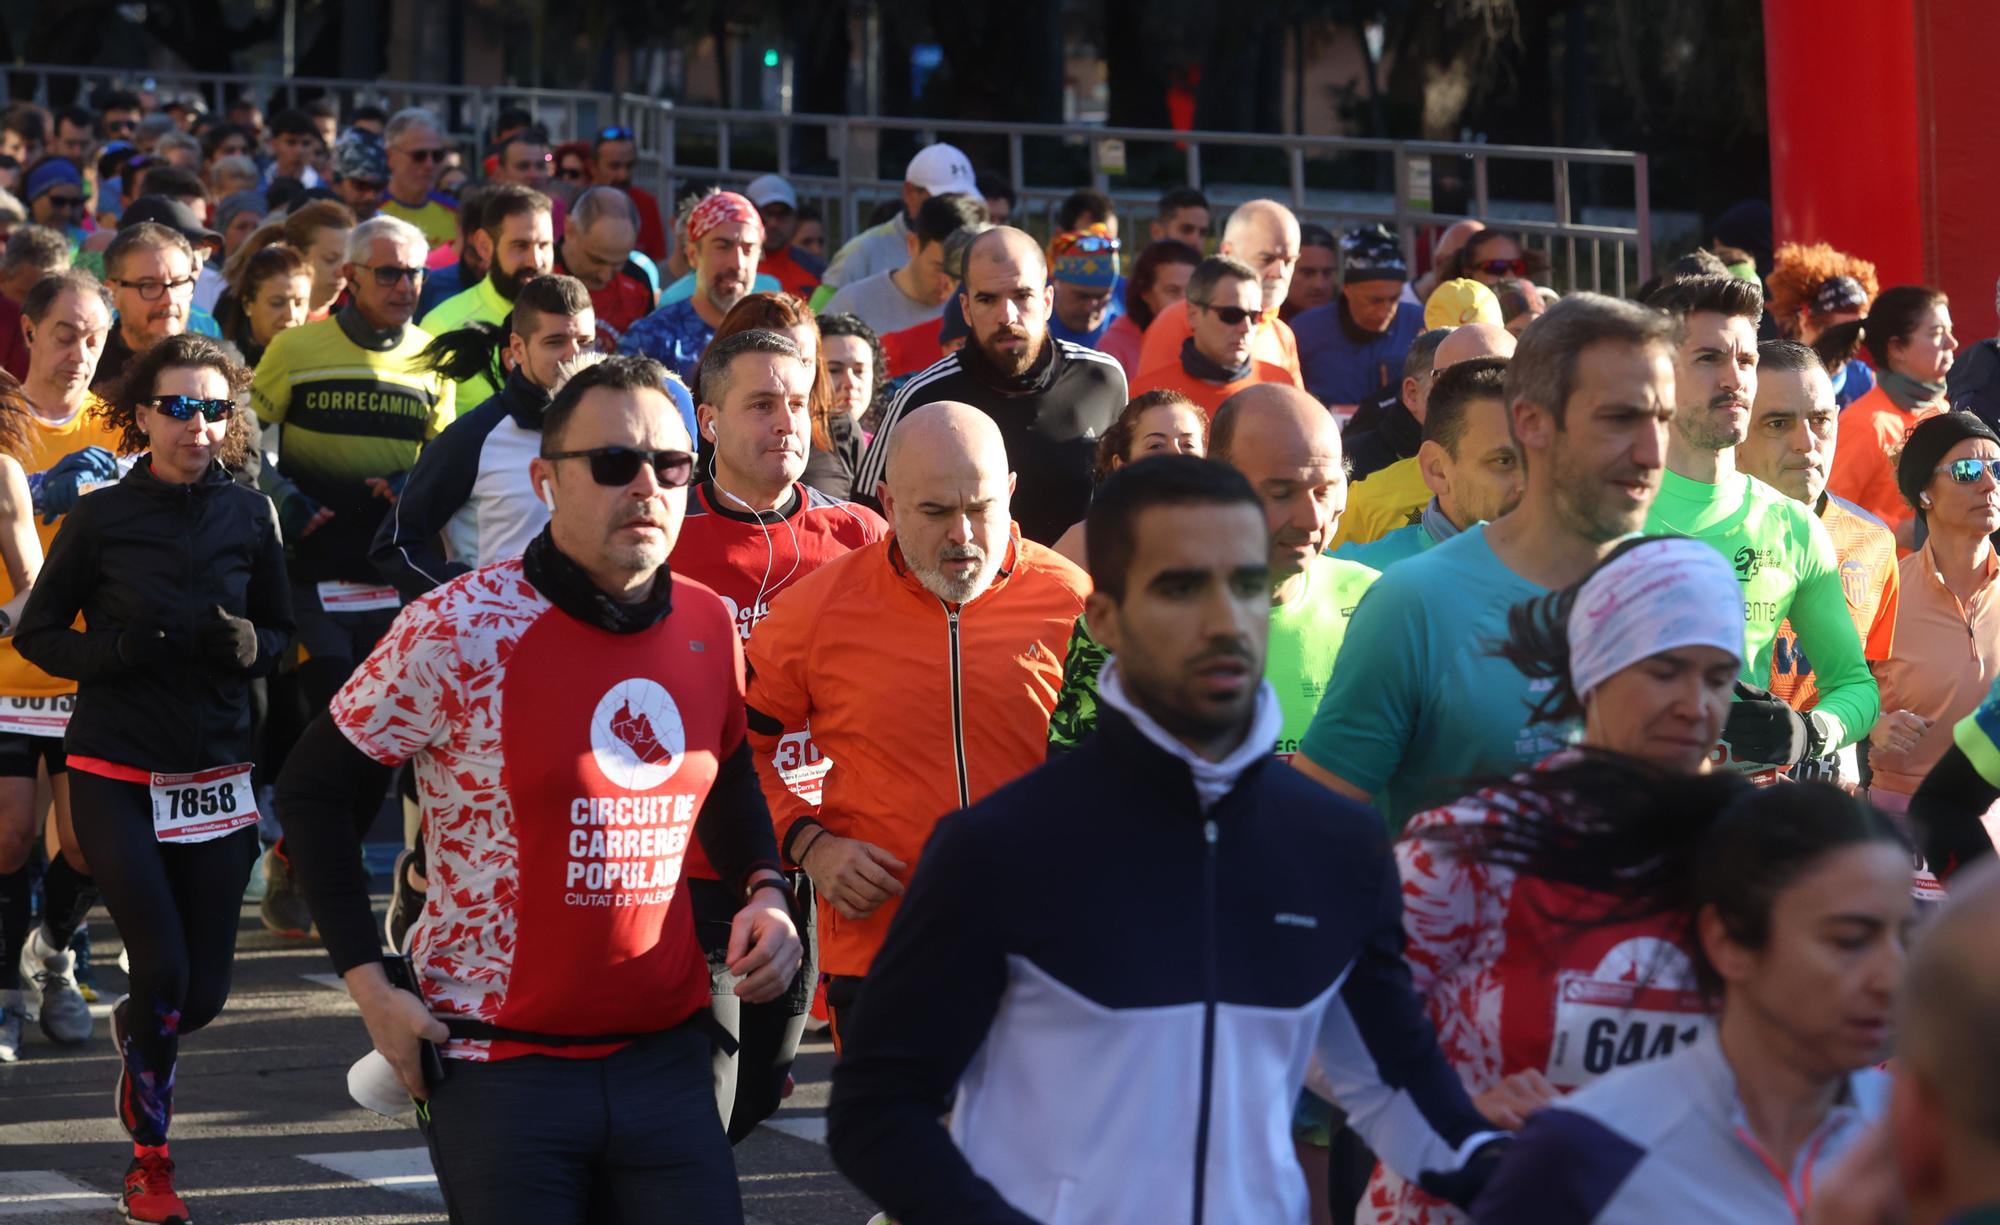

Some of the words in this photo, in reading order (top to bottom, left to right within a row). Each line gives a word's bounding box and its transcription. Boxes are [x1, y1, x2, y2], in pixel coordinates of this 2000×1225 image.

[166, 783, 236, 820] 7858
[570, 795, 672, 826] CIRCUIT
[672, 794, 696, 822] DE
[569, 824, 688, 858] CARRERES
[564, 893, 613, 906] CIUTAT
[615, 893, 633, 907] DE
